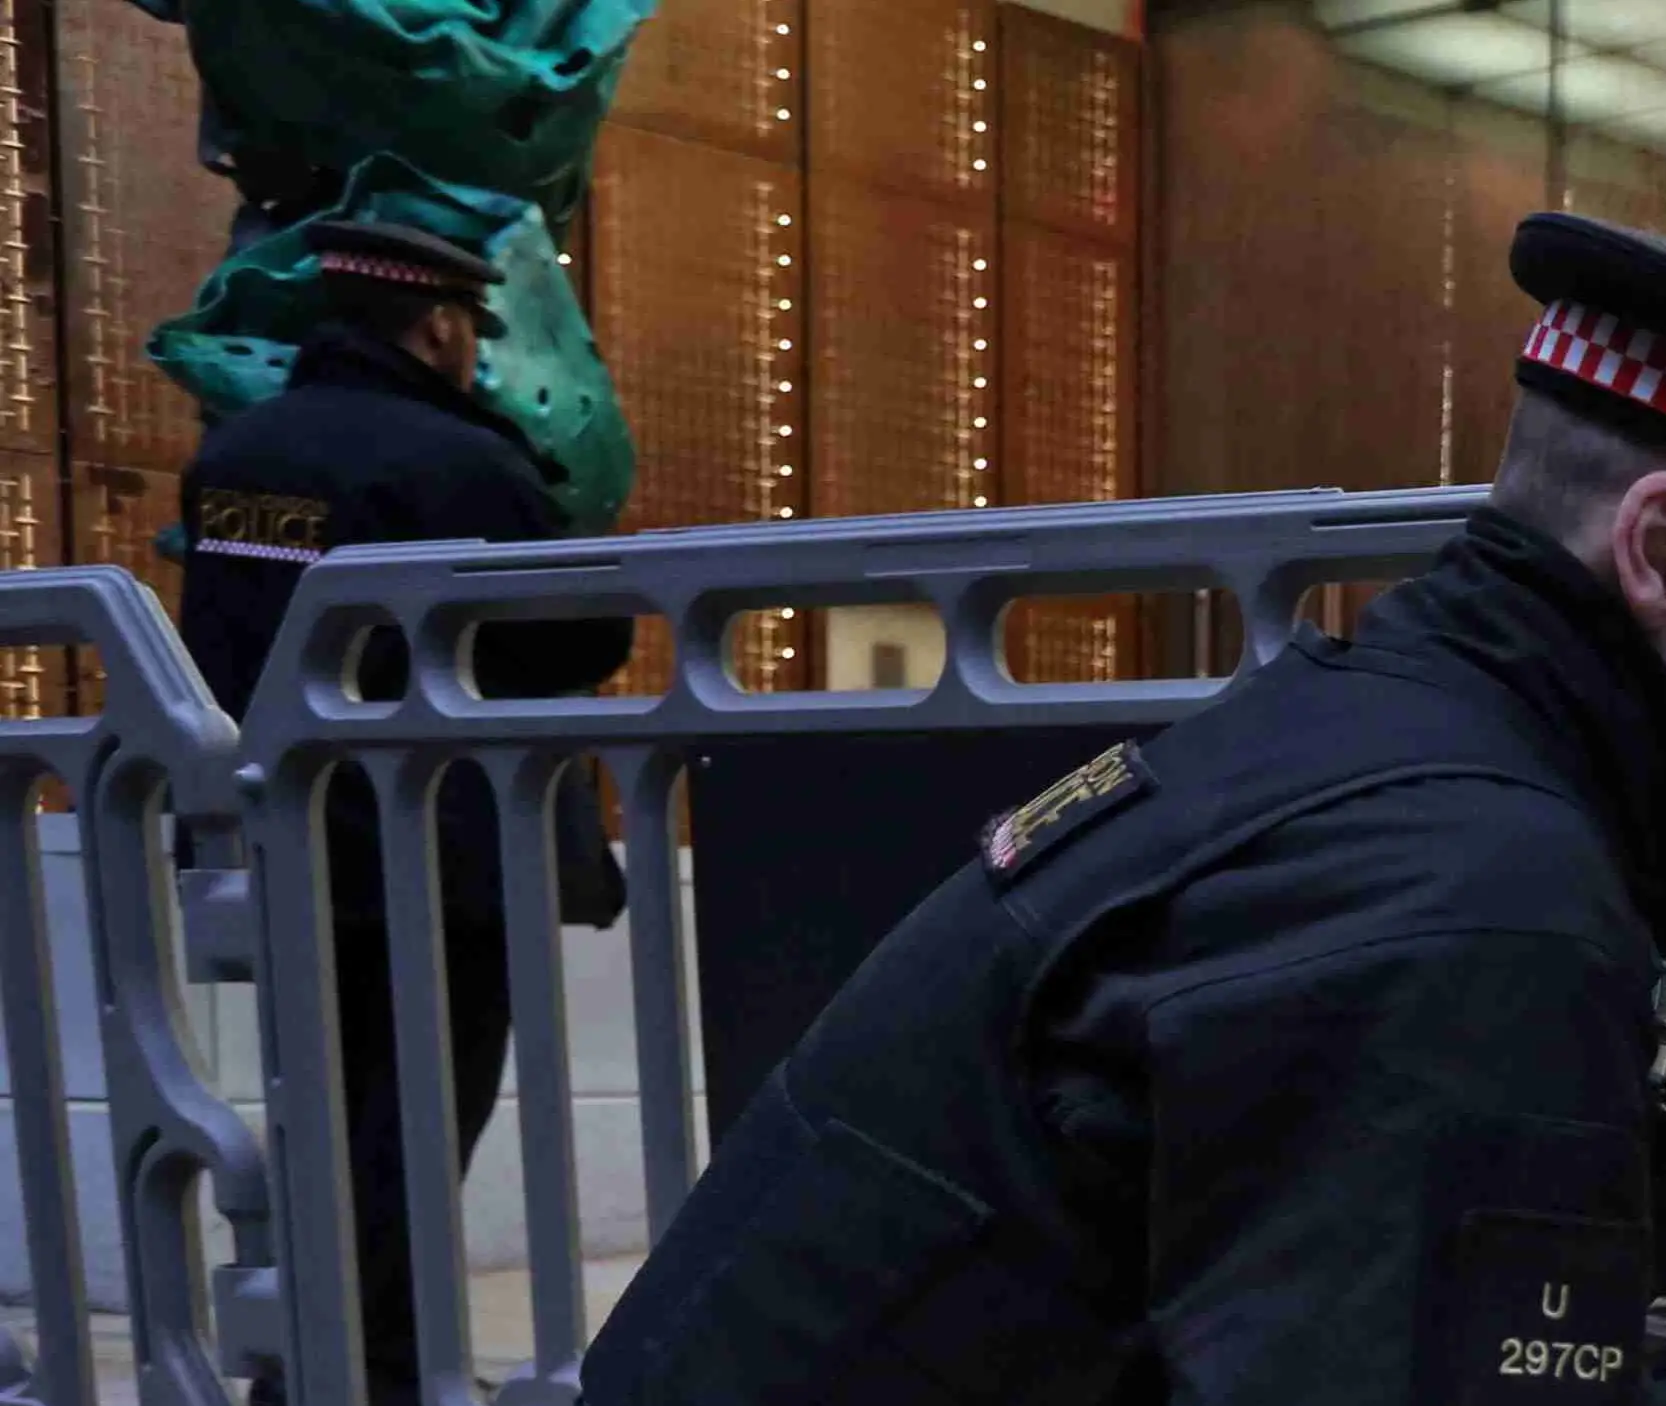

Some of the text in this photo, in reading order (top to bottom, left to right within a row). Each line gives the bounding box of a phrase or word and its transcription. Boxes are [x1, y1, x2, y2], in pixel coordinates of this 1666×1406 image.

[200, 503, 329, 548] POLICE
[1540, 1280, 1571, 1320] U
[1498, 1336, 1624, 1382] 297CP
